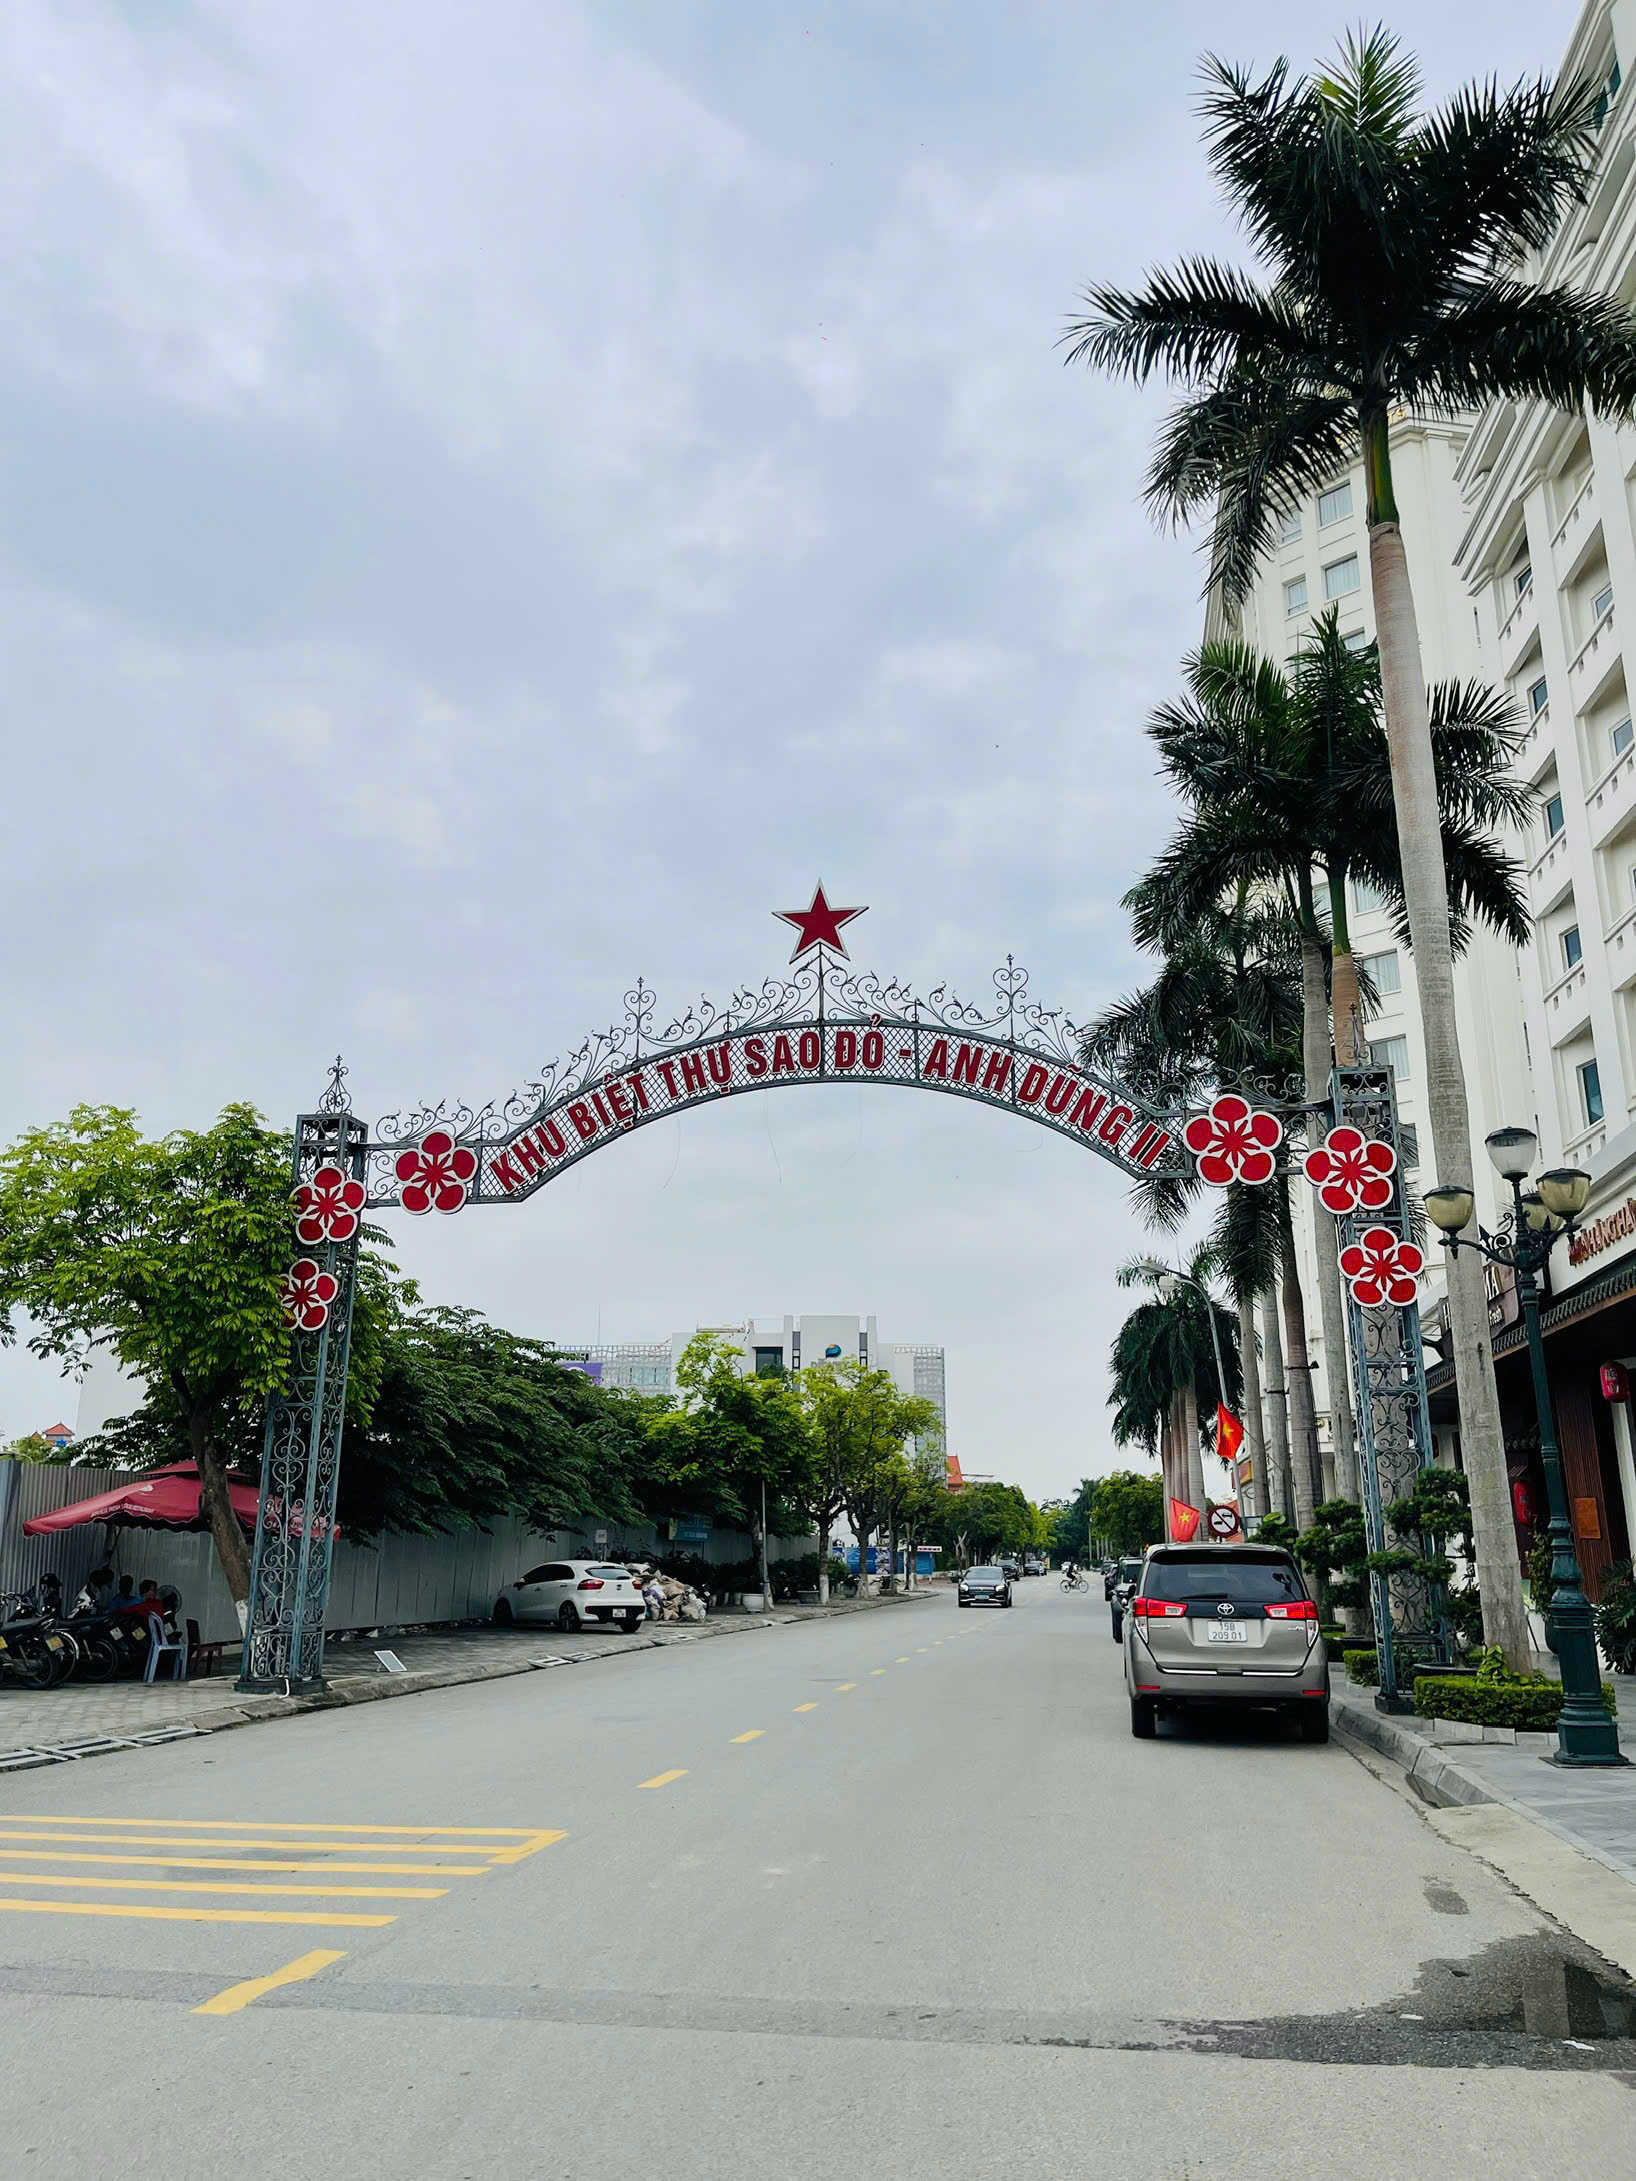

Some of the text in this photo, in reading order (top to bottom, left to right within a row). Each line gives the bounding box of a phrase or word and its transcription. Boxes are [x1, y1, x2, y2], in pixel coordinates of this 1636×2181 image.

[489, 1116, 567, 1194] KHU
[566, 1071, 650, 1142] BIỆT
[656, 1040, 735, 1100] THỰ
[743, 1031, 821, 1078] SAO
[834, 1013, 885, 1071] ĐỎ
[898, 1048, 913, 1059] -
[922, 1039, 1015, 1095] ANH
[1016, 1062, 1135, 1149] DŨNG
[1219, 1622, 1236, 1631] 15B
